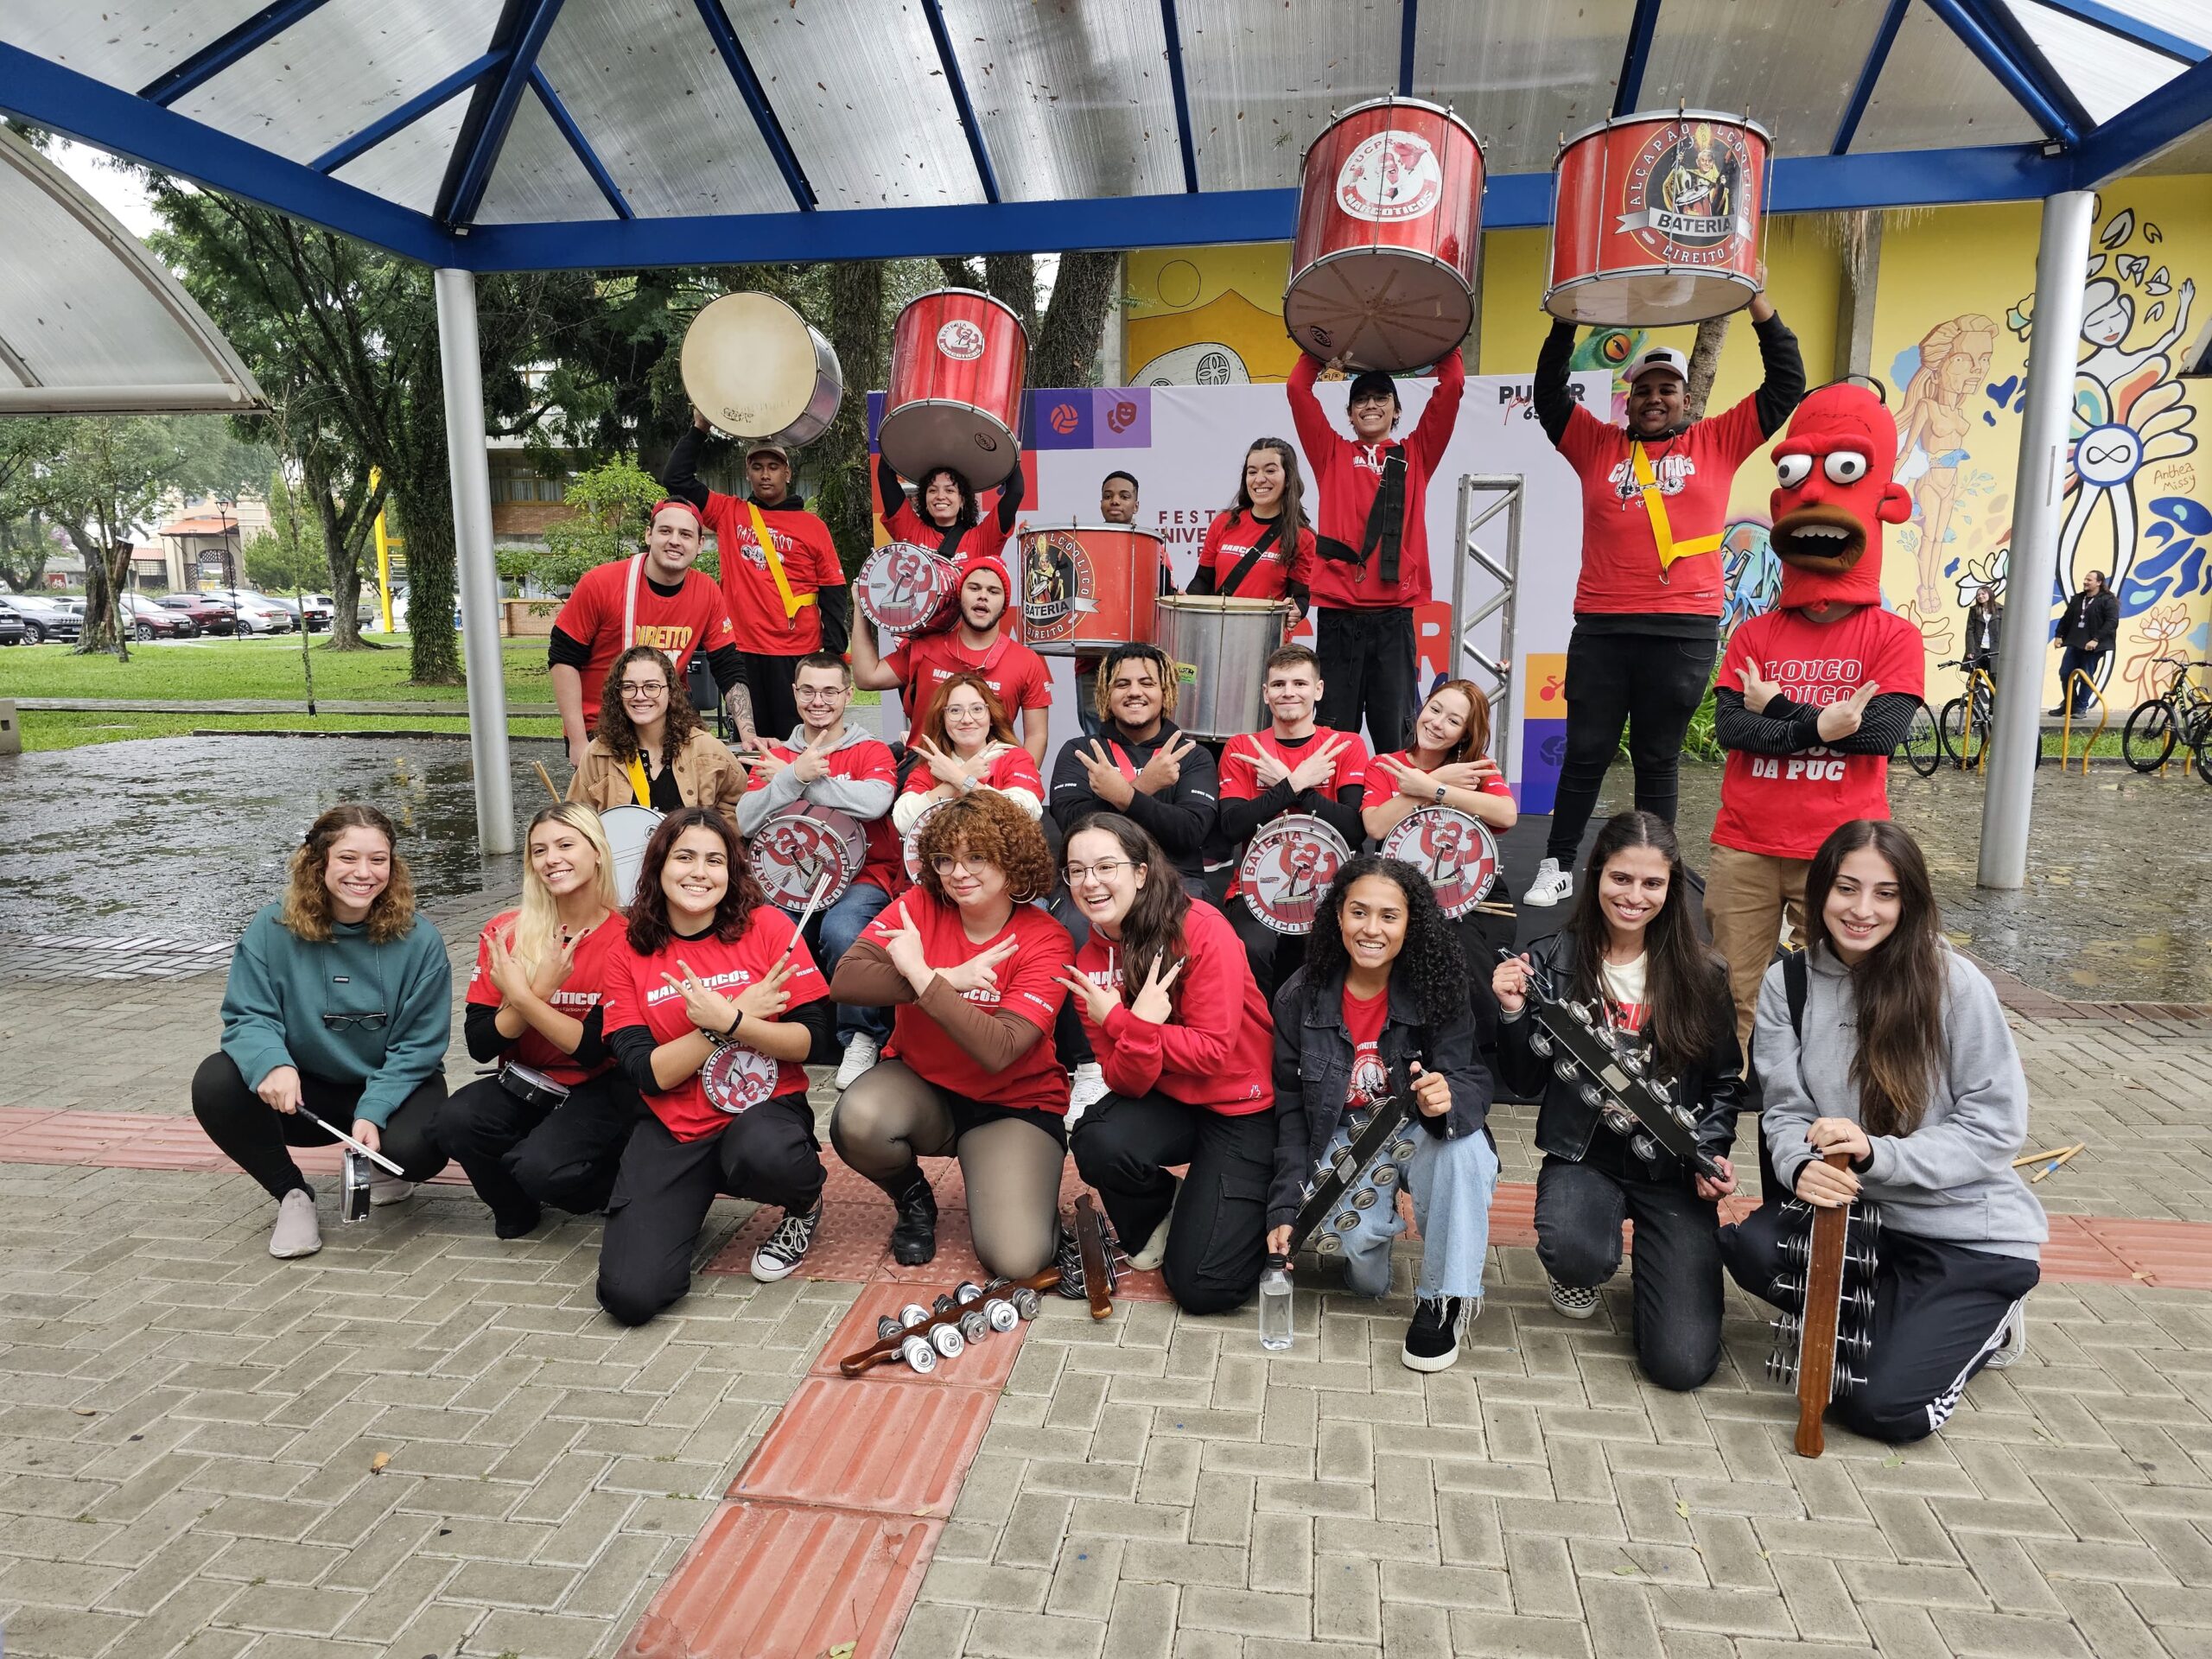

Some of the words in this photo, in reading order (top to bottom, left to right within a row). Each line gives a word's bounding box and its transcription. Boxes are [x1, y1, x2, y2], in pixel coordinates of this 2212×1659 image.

[1657, 213, 1733, 233] BATERIA
[1662, 246, 1726, 264] DIREITO
[2153, 462, 2195, 485] Anthea
[2163, 474, 2196, 495] Missy
[1026, 601, 1070, 616] BATERIA
[1027, 624, 1064, 639] DIREITO
[1764, 658, 1863, 683] LOUCO
[1778, 683, 1859, 709] OUCO
[1751, 758, 1779, 779] DA
[1785, 759, 1847, 781] PUC
[1244, 830, 1302, 876] BATERIA
